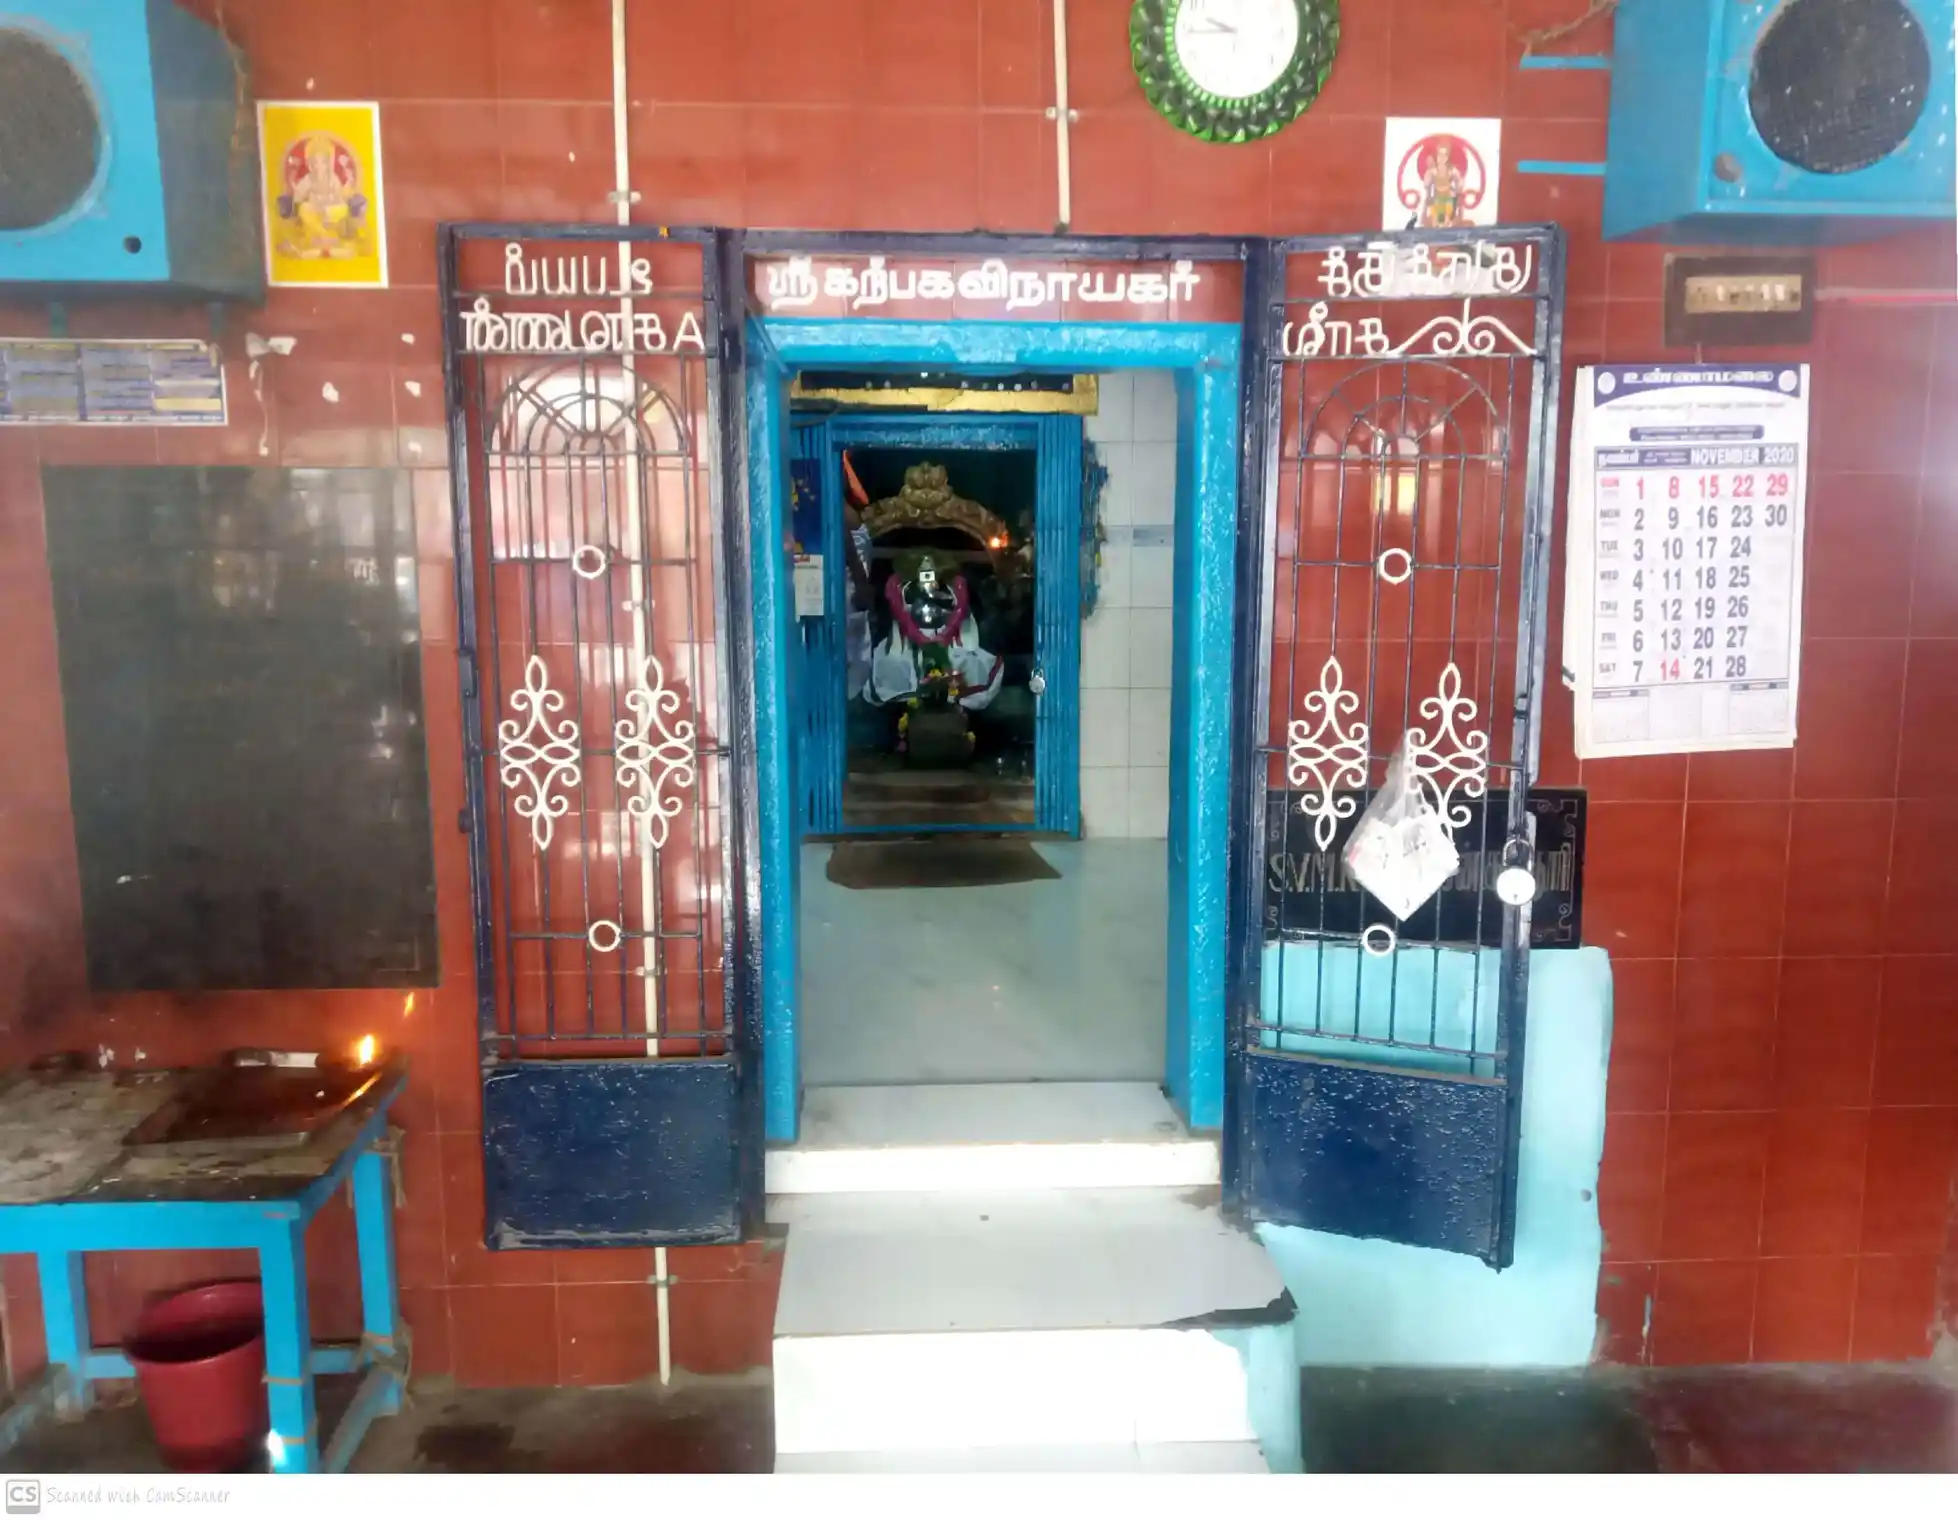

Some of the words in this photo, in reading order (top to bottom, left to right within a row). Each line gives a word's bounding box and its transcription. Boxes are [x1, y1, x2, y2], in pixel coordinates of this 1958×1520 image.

[1690, 447, 1759, 465] NOVEMBER
[1763, 446, 1795, 464] 2020
[1636, 476, 1644, 500] 1
[1668, 476, 1680, 499] 8
[1698, 474, 1719, 500] 15
[1732, 474, 1754, 498] 22
[1765, 472, 1788, 497] 29
[1634, 507, 1645, 531] 2
[1668, 506, 1679, 530] 9
[1696, 505, 1718, 529] 16
[1731, 504, 1753, 528] 23
[1764, 504, 1787, 528] 30
[1633, 538, 1644, 562] 3
[1662, 537, 1683, 561] 10
[1696, 536, 1718, 560] 17
[1730, 535, 1751, 559] 24
[1632, 569, 1643, 592] 4
[1663, 567, 1681, 591] 11
[1695, 566, 1716, 590] 18
[1728, 565, 1750, 588] 25
[1633, 599, 1643, 622] 5
[1661, 598, 1682, 621] 12
[1695, 596, 1716, 620] 19
[1727, 595, 1749, 618] 26
[1633, 629, 1644, 652] 6
[1661, 627, 1681, 651] 13
[1693, 626, 1714, 649] 20
[1726, 626, 1748, 648] 27
[1633, 660, 1643, 682] 7
[1660, 658, 1680, 682] 14
[1693, 656, 1713, 679] 21
[1726, 655, 1747, 678] 28
